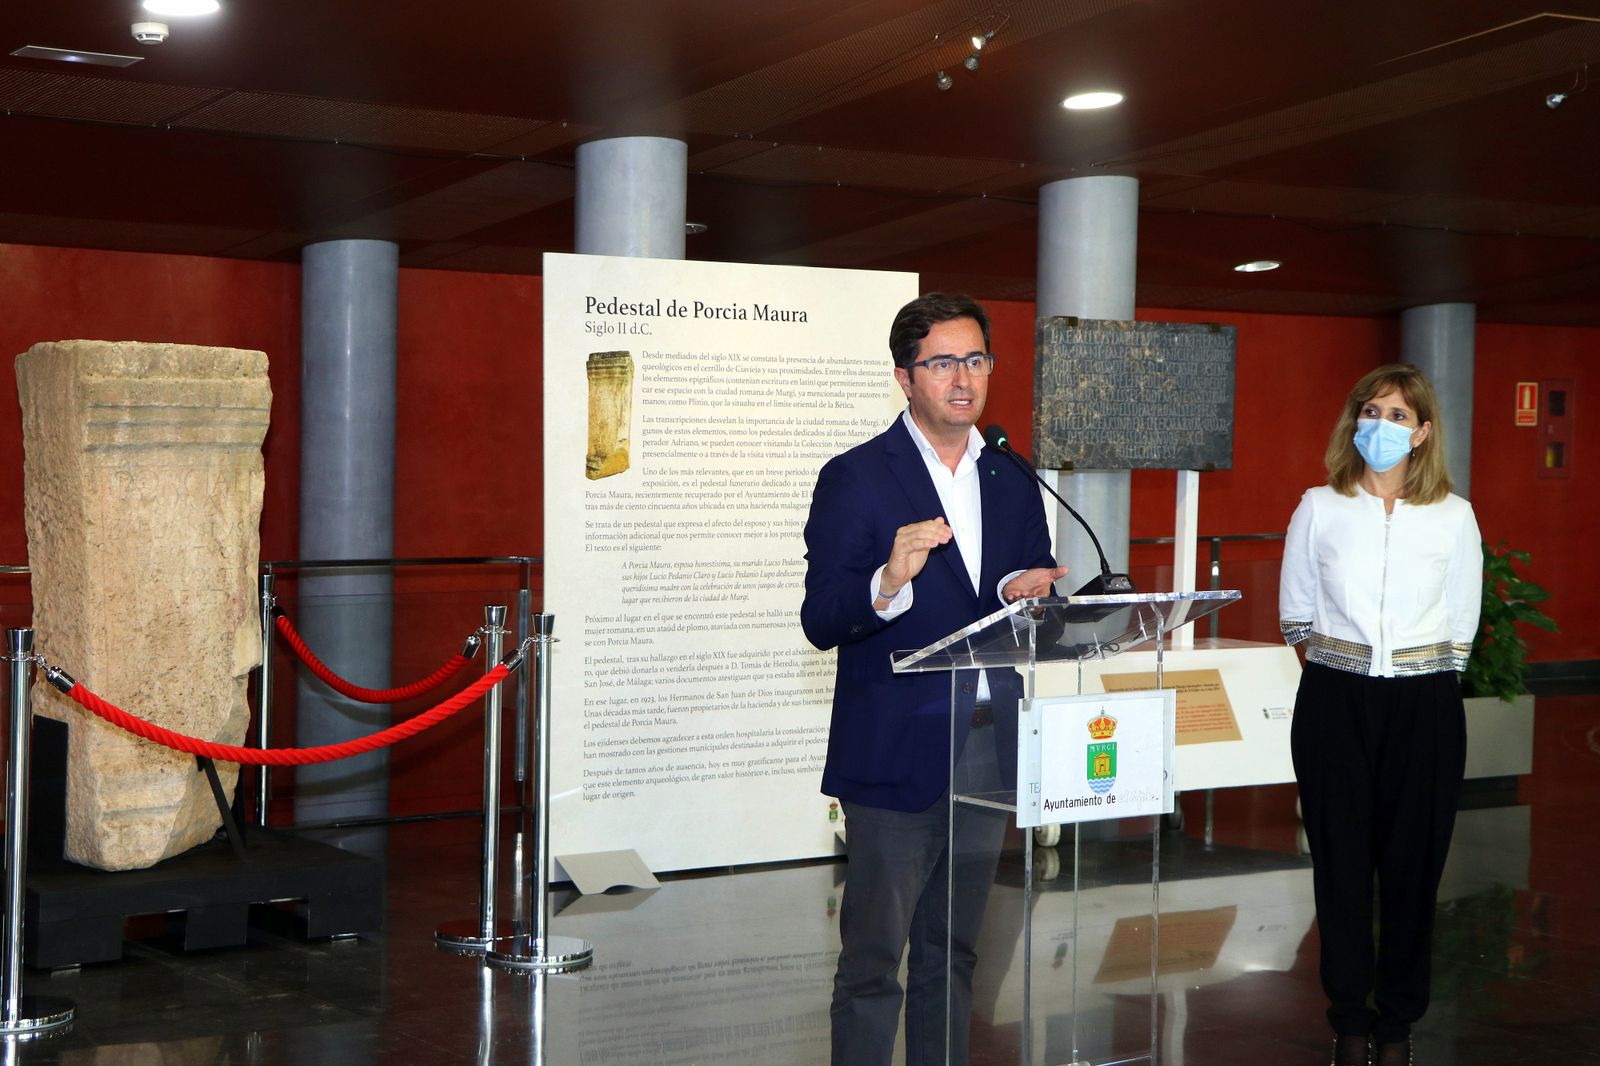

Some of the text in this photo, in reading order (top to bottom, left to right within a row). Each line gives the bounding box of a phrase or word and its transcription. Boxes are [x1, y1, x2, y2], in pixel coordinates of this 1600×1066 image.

[586, 296, 808, 322] Pedestal de Porcia Maura
[585, 321, 652, 336] Siglo II d.C.
[786, 355, 816, 364] presencia
[826, 356, 863, 364] abundantes
[642, 363, 683, 373] queológicos
[858, 368, 891, 376] destacaron
[688, 376, 725, 385] epigráficos
[829, 378, 866, 388] permitieron
[667, 387, 693, 396] espacio
[655, 416, 707, 425] transcripciones
[745, 417, 785, 426] importancia
[759, 428, 792, 437] pedestales
[642, 439, 669, 448] perador
[709, 439, 735, 448] pueden
[642, 450, 698, 459] presencialmente
[700, 479, 728, 488] pedestal
[684, 490, 723, 500] recuperado
[744, 490, 791, 500] Ayuntamiento
[633, 520, 663, 529] pedestal
[689, 531, 716, 540] permite
[684, 612, 714, 620] encontró
[729, 610, 757, 620] pedestal
[649, 654, 678, 662] hallazgo
[738, 650, 771, 660] adquirido
[631, 665, 659, 674] donarla
[666, 664, 696, 672] venderla
[696, 663, 724, 672] después
[718, 673, 752, 682] atestiguan
[774, 688, 814, 697] inauguraron
[690, 702, 730, 713] propietarios
[747, 700, 777, 708] hacienda
[591, 720, 621, 730] pedestal
[597, 738, 629, 748] ejidenses
[662, 734, 695, 744] agradecer
[736, 728, 774, 739] hospitalaria
[782, 725, 826, 735] consideración
[598, 748, 632, 757] mostrado
[656, 746, 688, 756] gestiones
[689, 743, 729, 752] municipales
[730, 741, 765, 749] destinadas
[1090, 744, 1114, 752] MVRGI
[584, 768, 613, 778] Después
[747, 757, 784, 768] gratificante
[735, 769, 764, 778] histórico
[1044, 795, 1102, 812] Ayuntamiento
[1106, 794, 1116, 804] de
